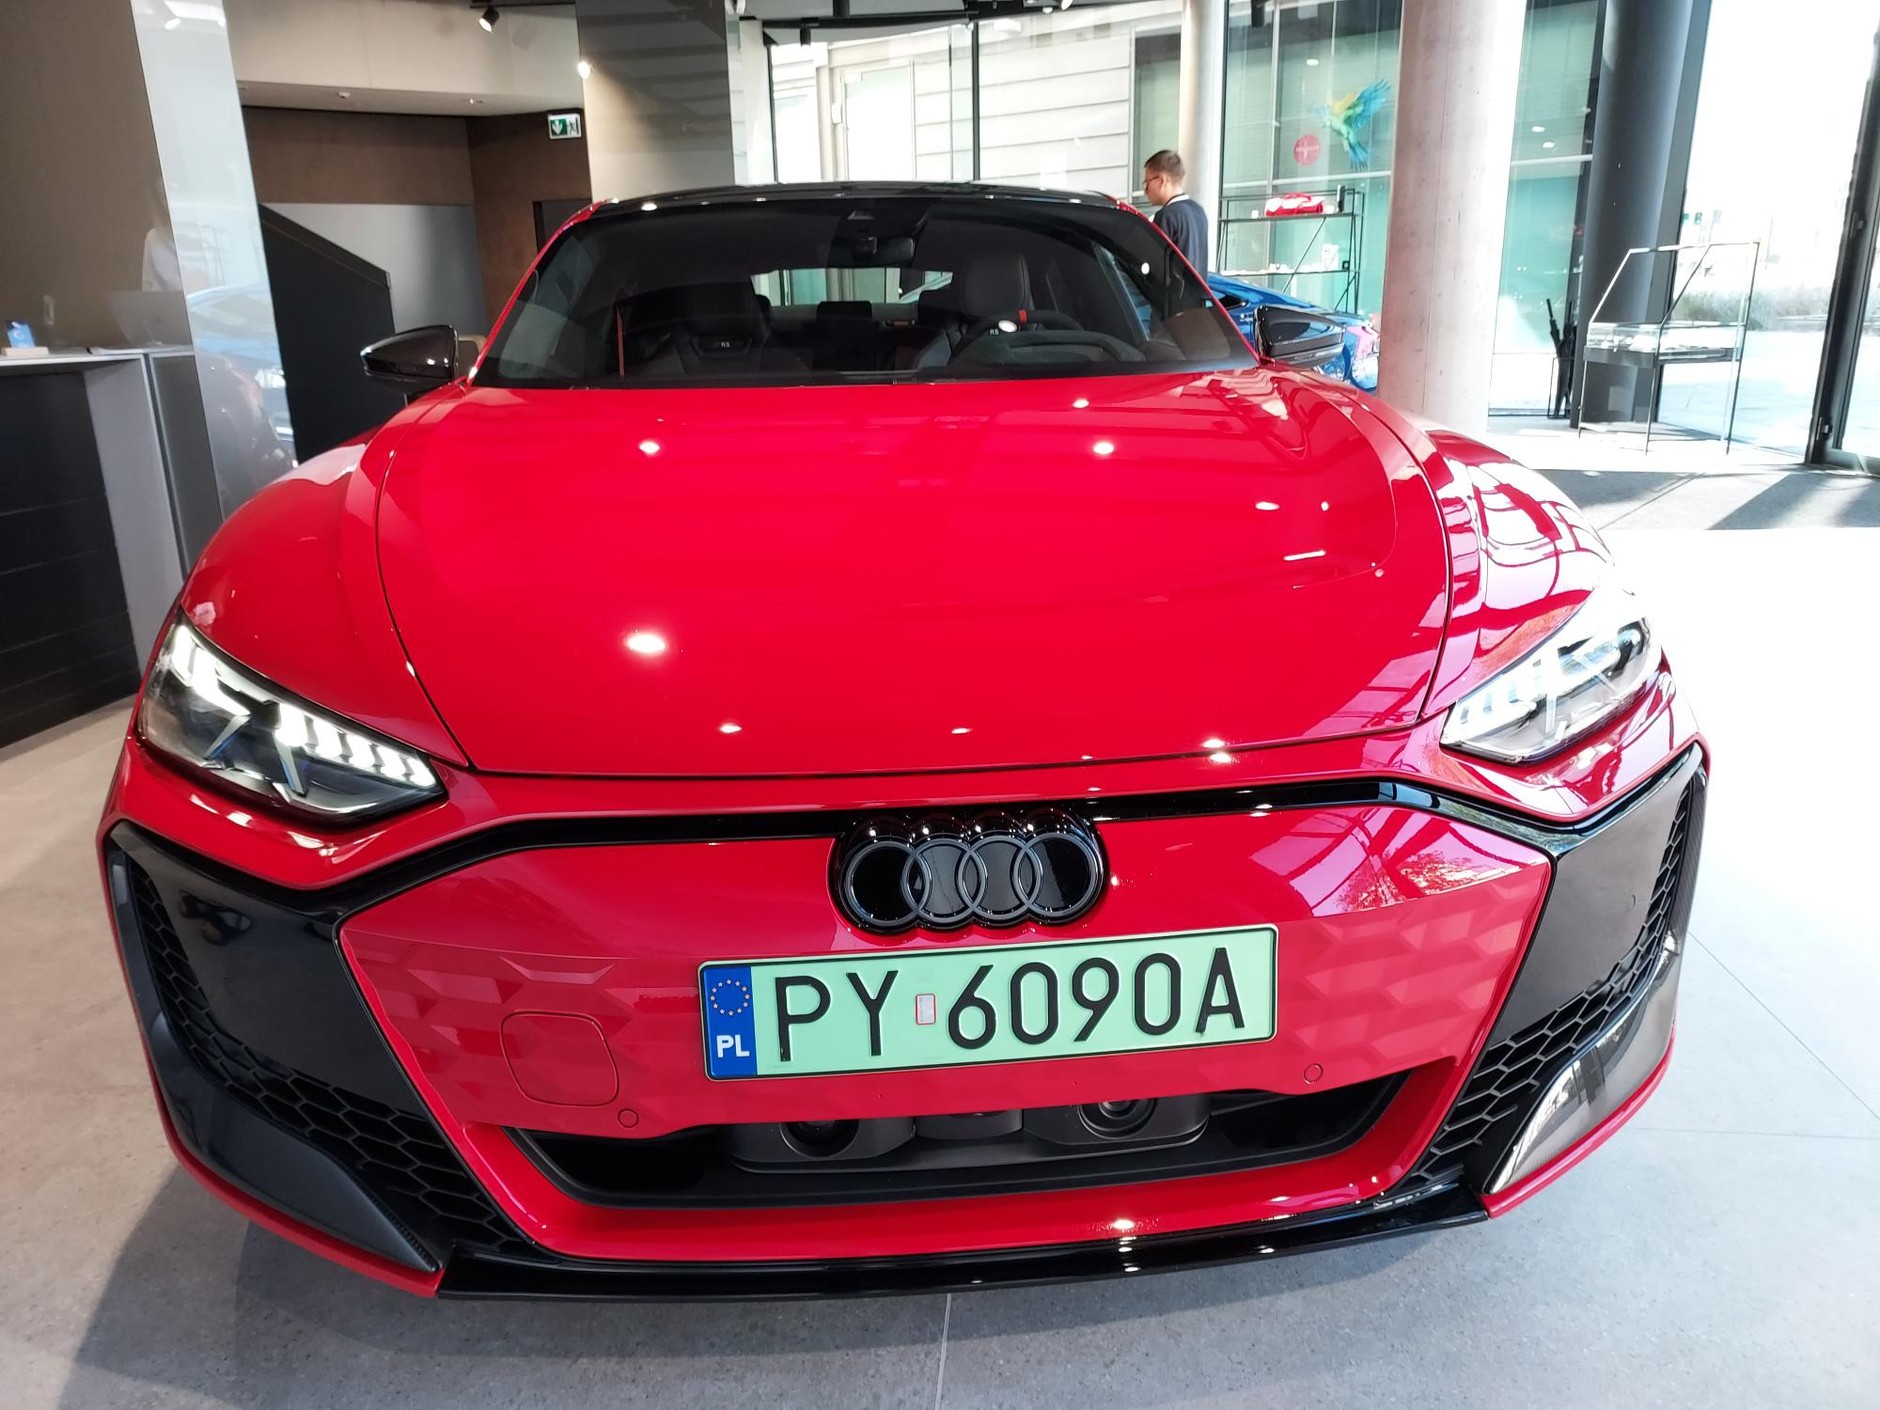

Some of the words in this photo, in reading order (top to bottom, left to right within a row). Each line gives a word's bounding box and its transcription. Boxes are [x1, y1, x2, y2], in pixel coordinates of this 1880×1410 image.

[775, 969, 899, 1062] PY
[948, 947, 1245, 1050] 6090A
[716, 1034, 750, 1058] PL
